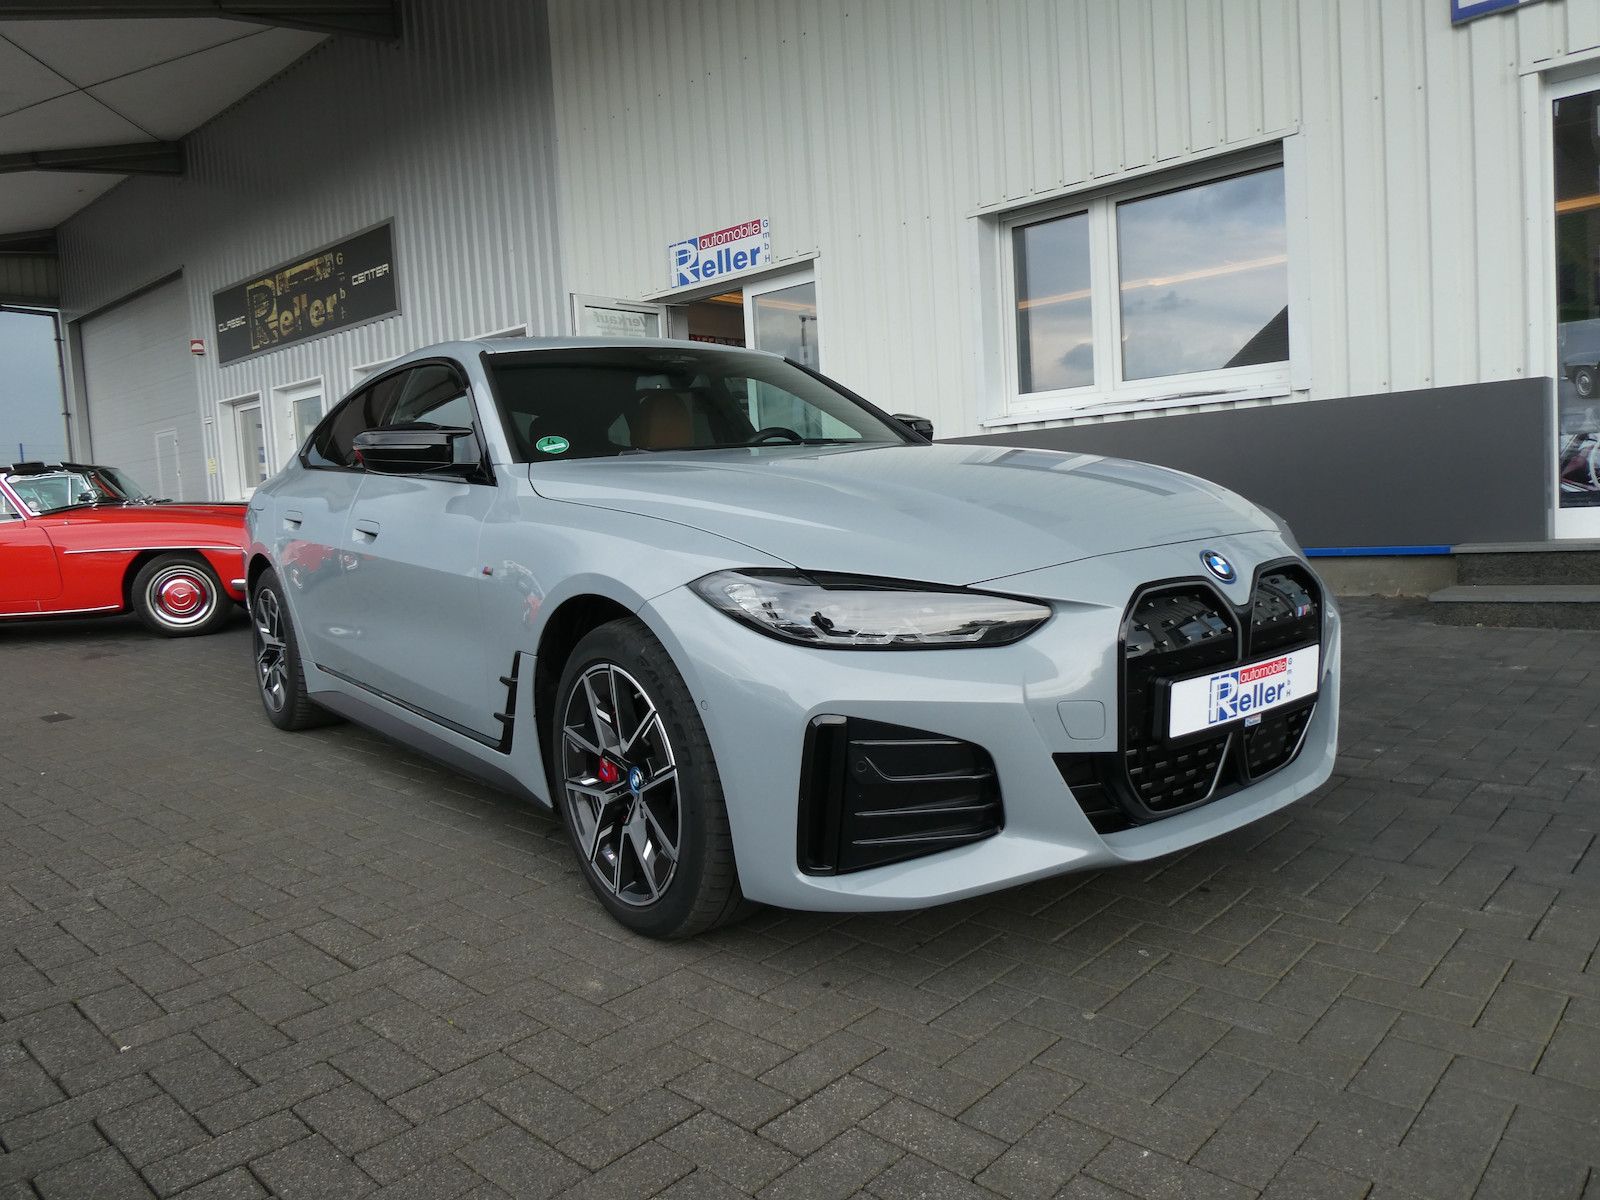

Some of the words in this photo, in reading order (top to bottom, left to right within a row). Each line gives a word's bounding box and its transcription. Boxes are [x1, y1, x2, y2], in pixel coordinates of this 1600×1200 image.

[700, 222, 760, 249] automobile
[351, 263, 389, 286] CENTER
[669, 238, 760, 288] Reller
[1240, 661, 1286, 683] automobile
[1209, 671, 1285, 724] Reller
